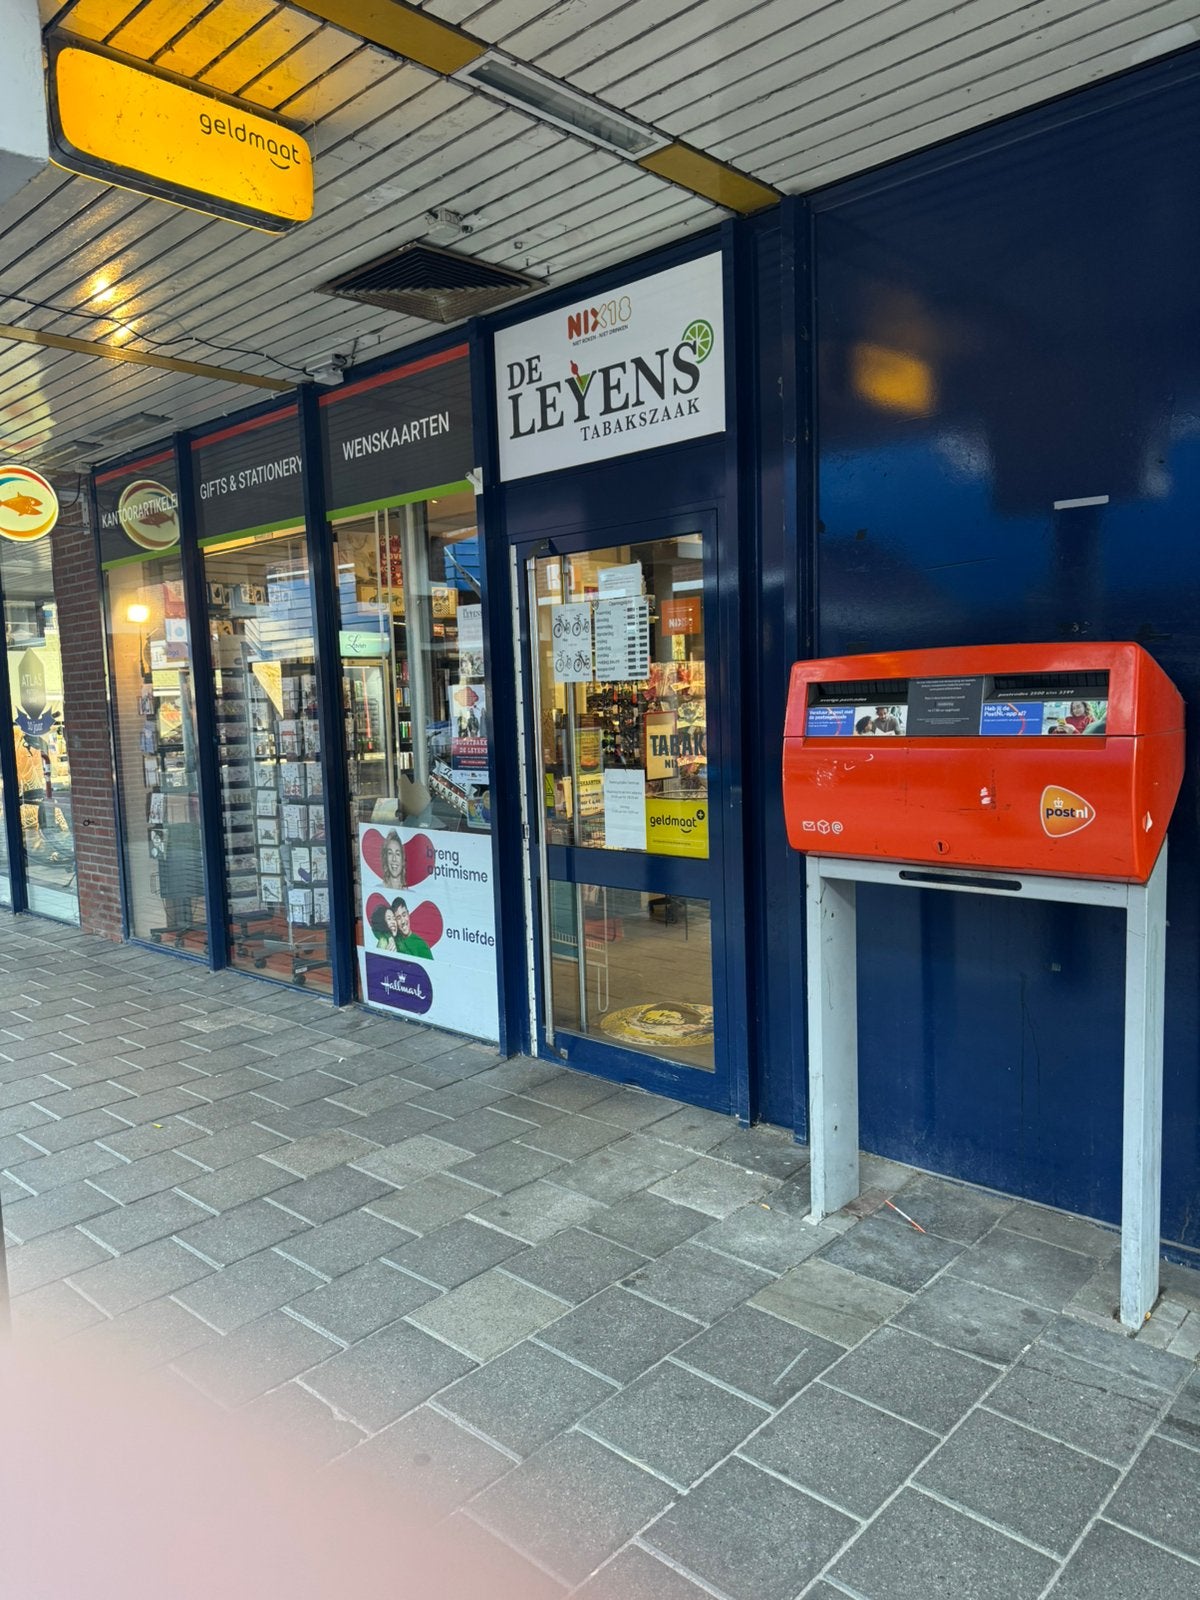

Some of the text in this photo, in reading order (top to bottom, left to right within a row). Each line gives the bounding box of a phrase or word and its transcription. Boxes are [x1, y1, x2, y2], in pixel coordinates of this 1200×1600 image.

[199, 113, 301, 166] geldmaat
[567, 295, 632, 341] NIX18
[582, 335, 597, 343] ROKEN
[599, 330, 609, 338] NIET
[609, 324, 629, 335] DRINKEN
[506, 355, 542, 391] DE
[508, 341, 701, 440] LEYENS
[580, 397, 701, 442] TABAKSZAAK
[342, 411, 450, 461] WENSKAARTEN
[200, 455, 303, 500] GIFTS & STATIONERY
[21, 673, 43, 688] ATLAS
[649, 733, 706, 757] TABAK
[650, 815, 697, 828] geldmaat
[1046, 806, 1088, 819] postnl
[426, 845, 460, 866] breng
[427, 864, 488, 883] optimisme
[446, 927, 495, 947] en liefde
[381, 976, 426, 1000] Hallmark
